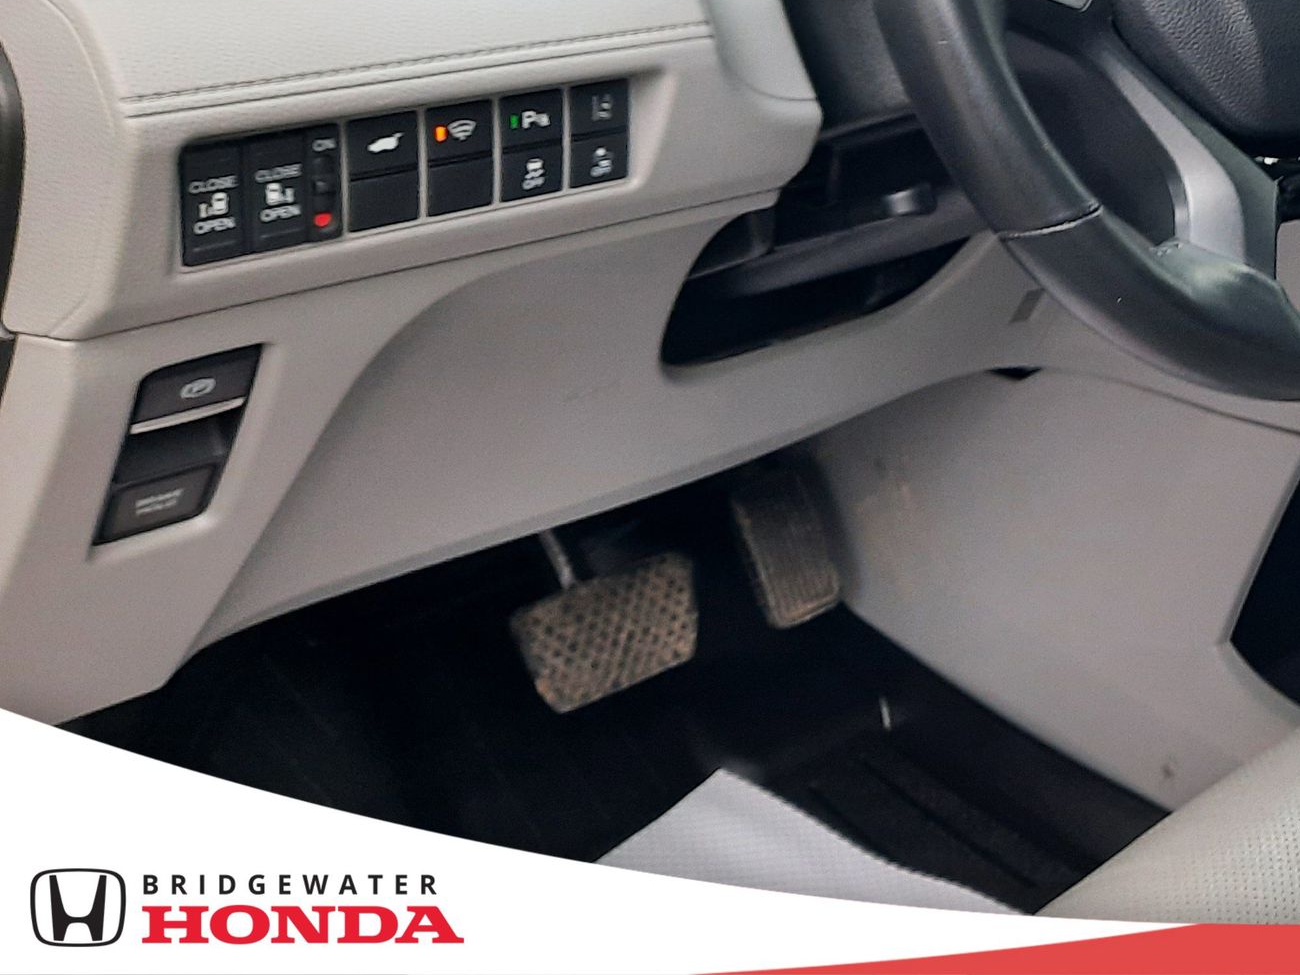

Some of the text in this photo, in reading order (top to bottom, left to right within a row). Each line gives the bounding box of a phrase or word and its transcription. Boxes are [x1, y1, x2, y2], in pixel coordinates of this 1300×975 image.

[255, 163, 303, 183] CLOSE
[188, 175, 239, 194] CLOSE
[260, 204, 301, 222] OPEN
[193, 216, 236, 235] OPEN
